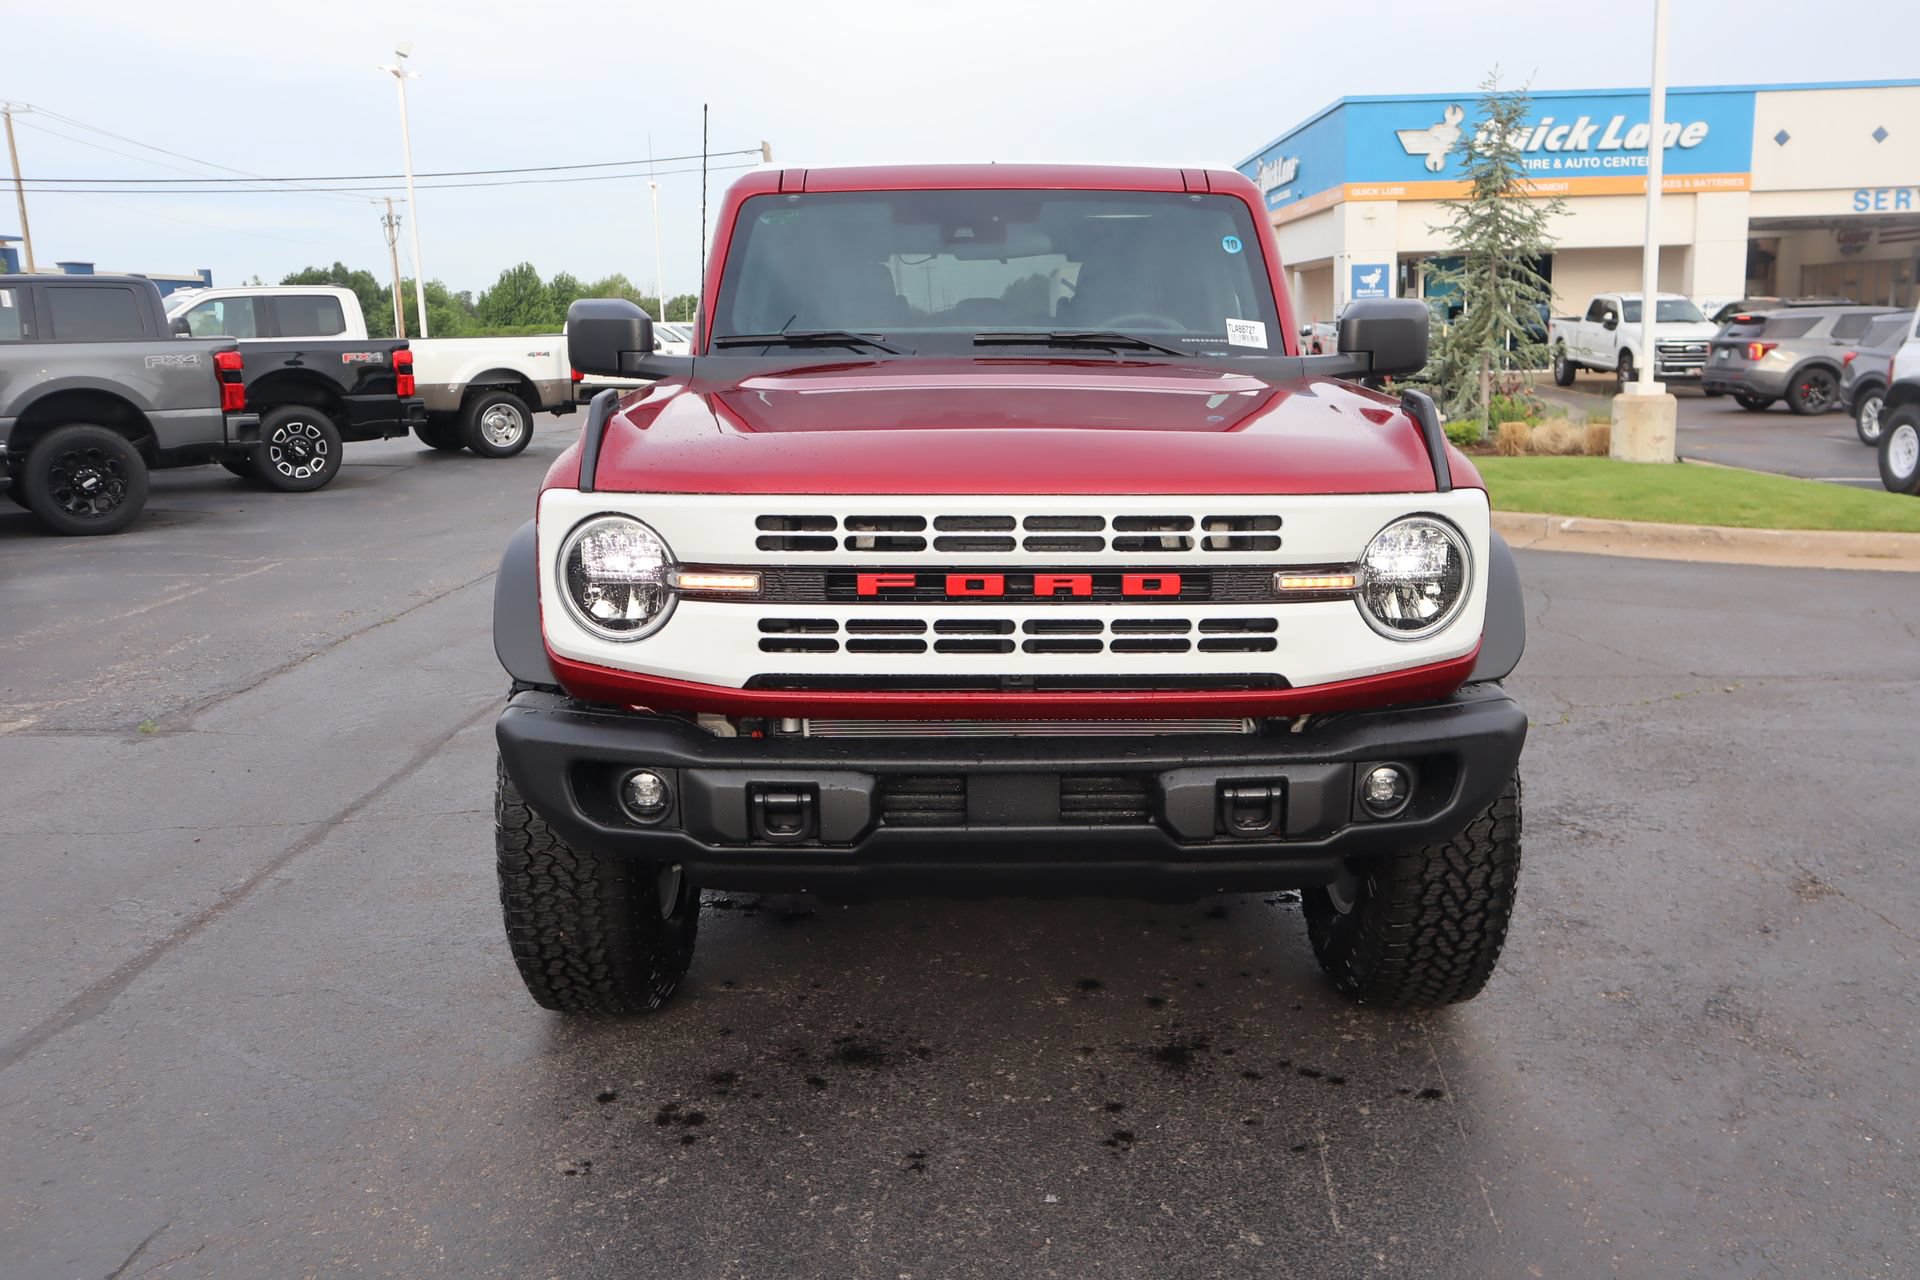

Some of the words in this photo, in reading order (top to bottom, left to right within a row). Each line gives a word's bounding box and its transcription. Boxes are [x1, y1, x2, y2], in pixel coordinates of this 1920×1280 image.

[1597, 114, 1709, 150] Lane
[1521, 159, 1550, 169] TIRE
[1553, 158, 1562, 169] &
[1564, 157, 1600, 168] AUTO
[1853, 187, 1920, 212] SER
[145, 354, 200, 368] FX4
[342, 352, 384, 364] FX4
[857, 574, 1181, 596] FORD
